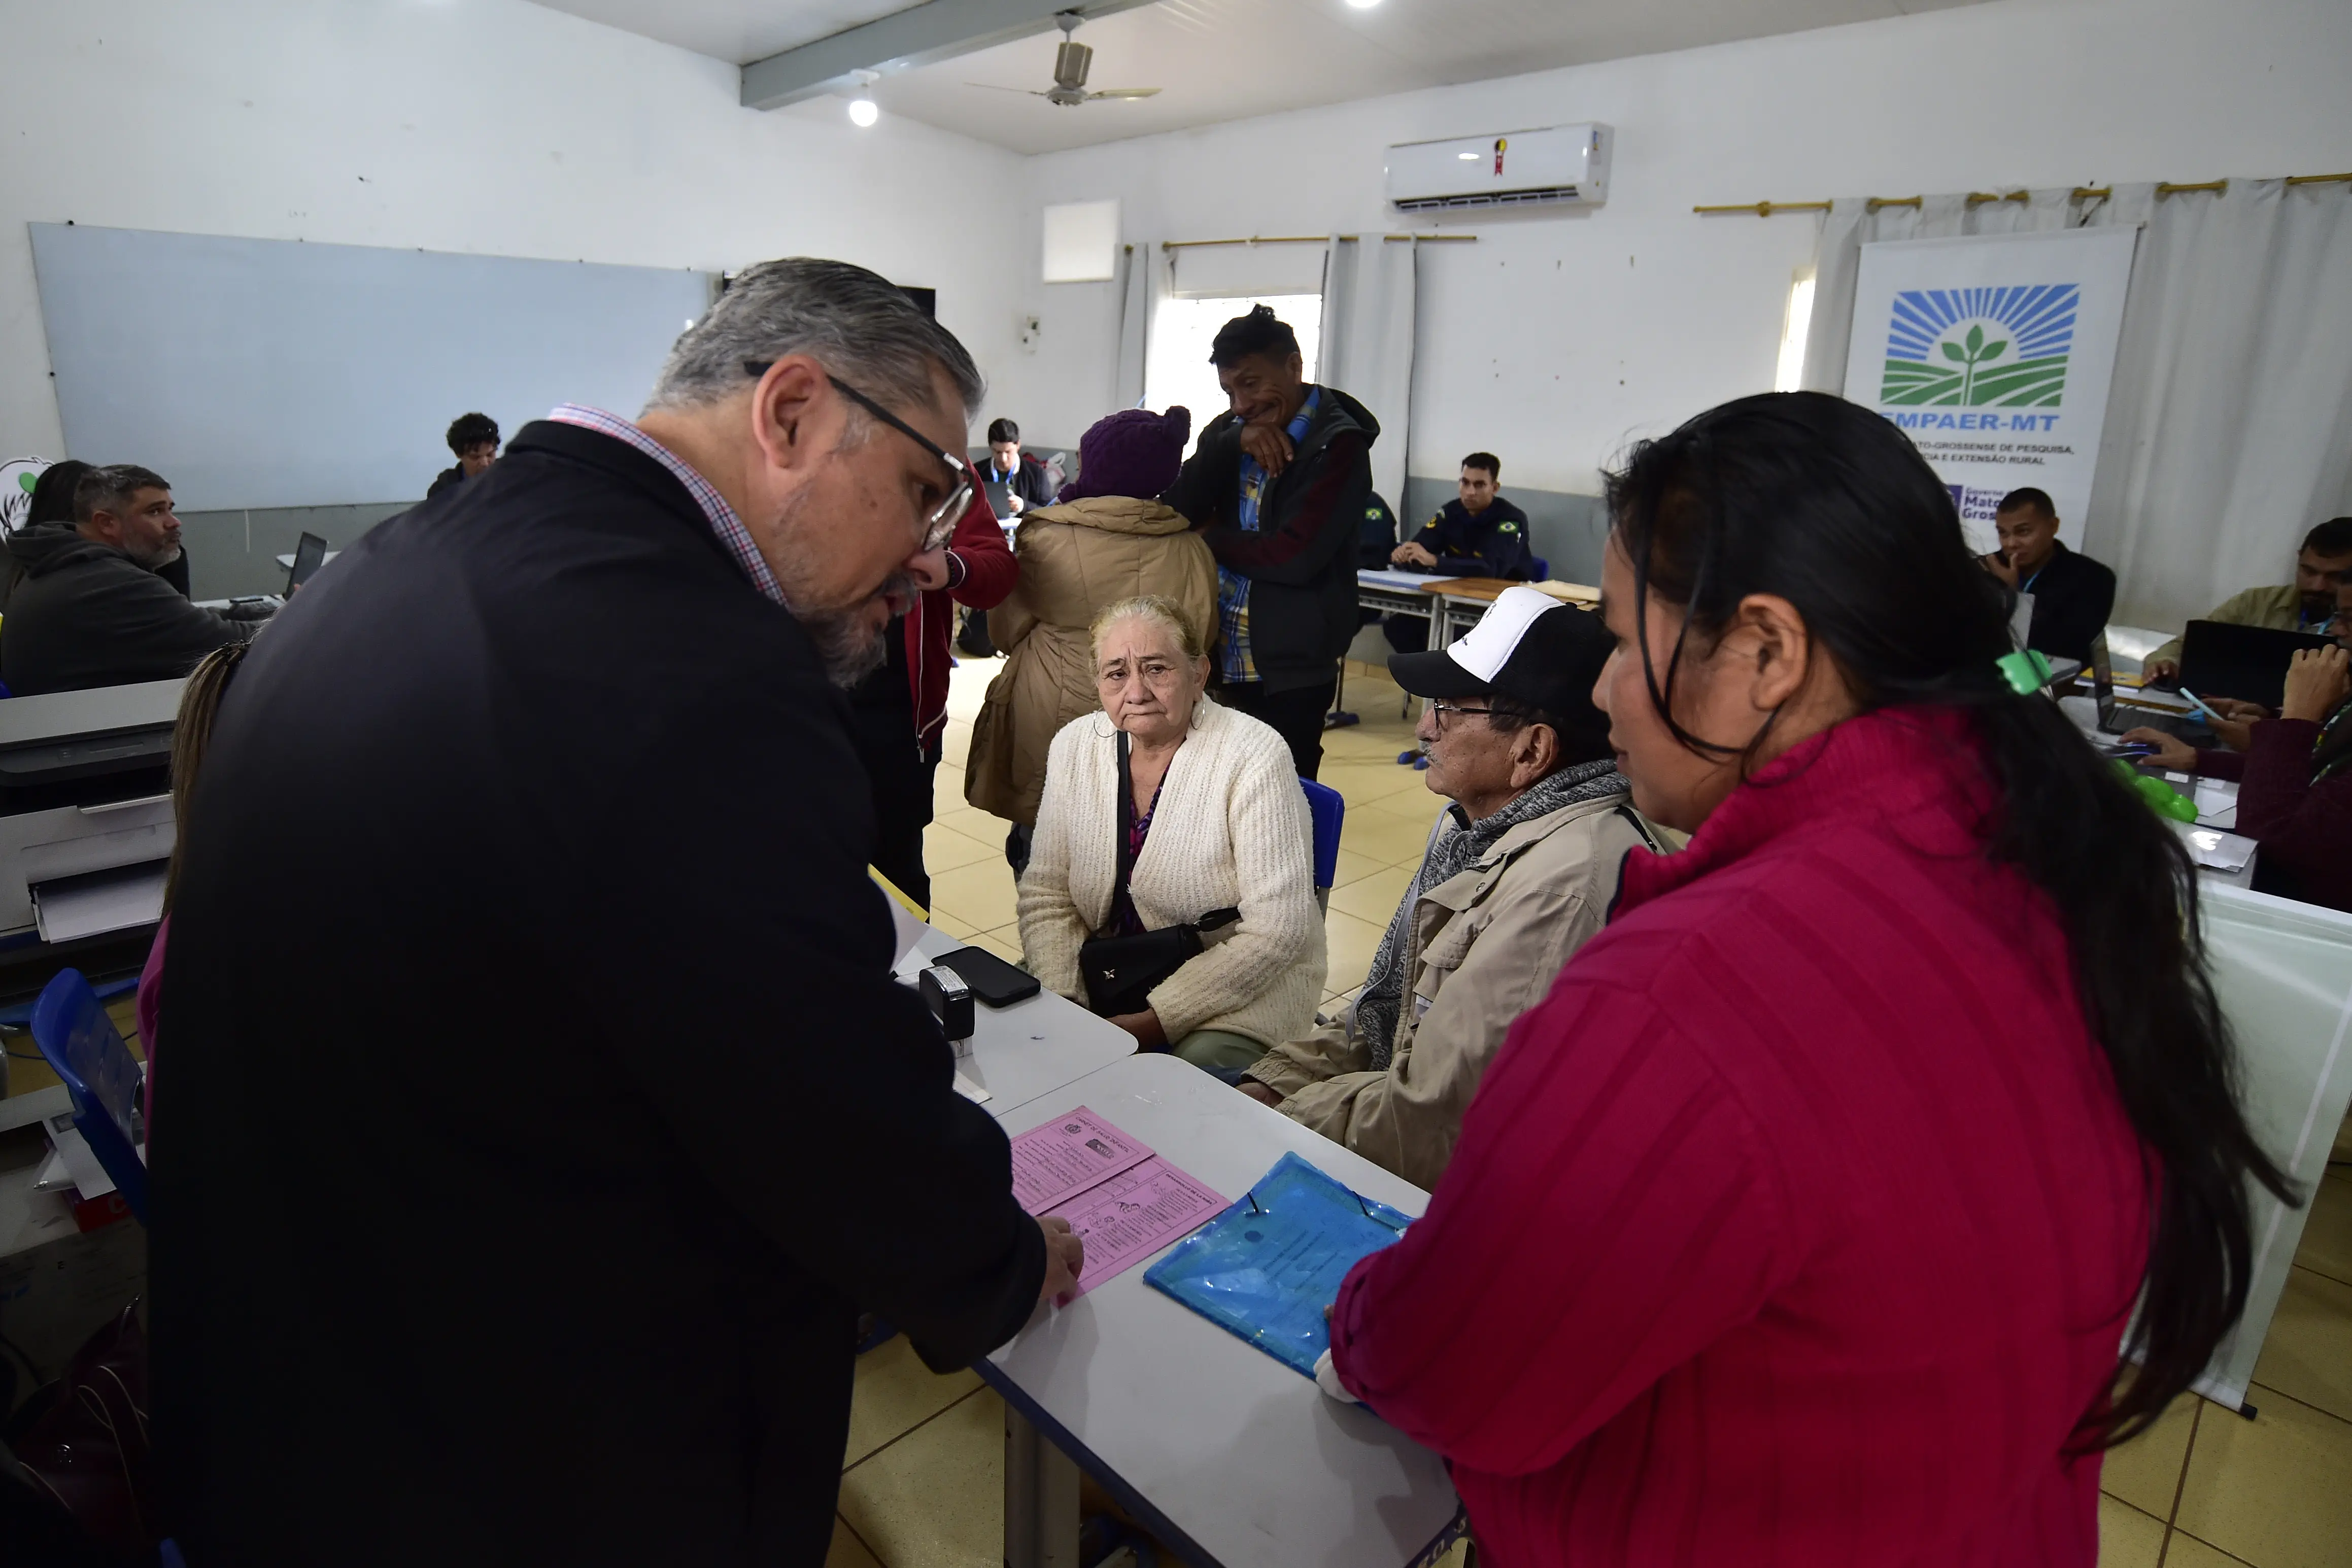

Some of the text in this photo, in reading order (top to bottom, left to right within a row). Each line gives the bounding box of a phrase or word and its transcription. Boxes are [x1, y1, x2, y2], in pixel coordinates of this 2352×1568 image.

[1999, 444, 2014, 452] DE
[1951, 453, 2006, 464] EXTENSÃO
[2009, 455, 2046, 465] RURAL
[1963, 508, 1996, 521] Gros
